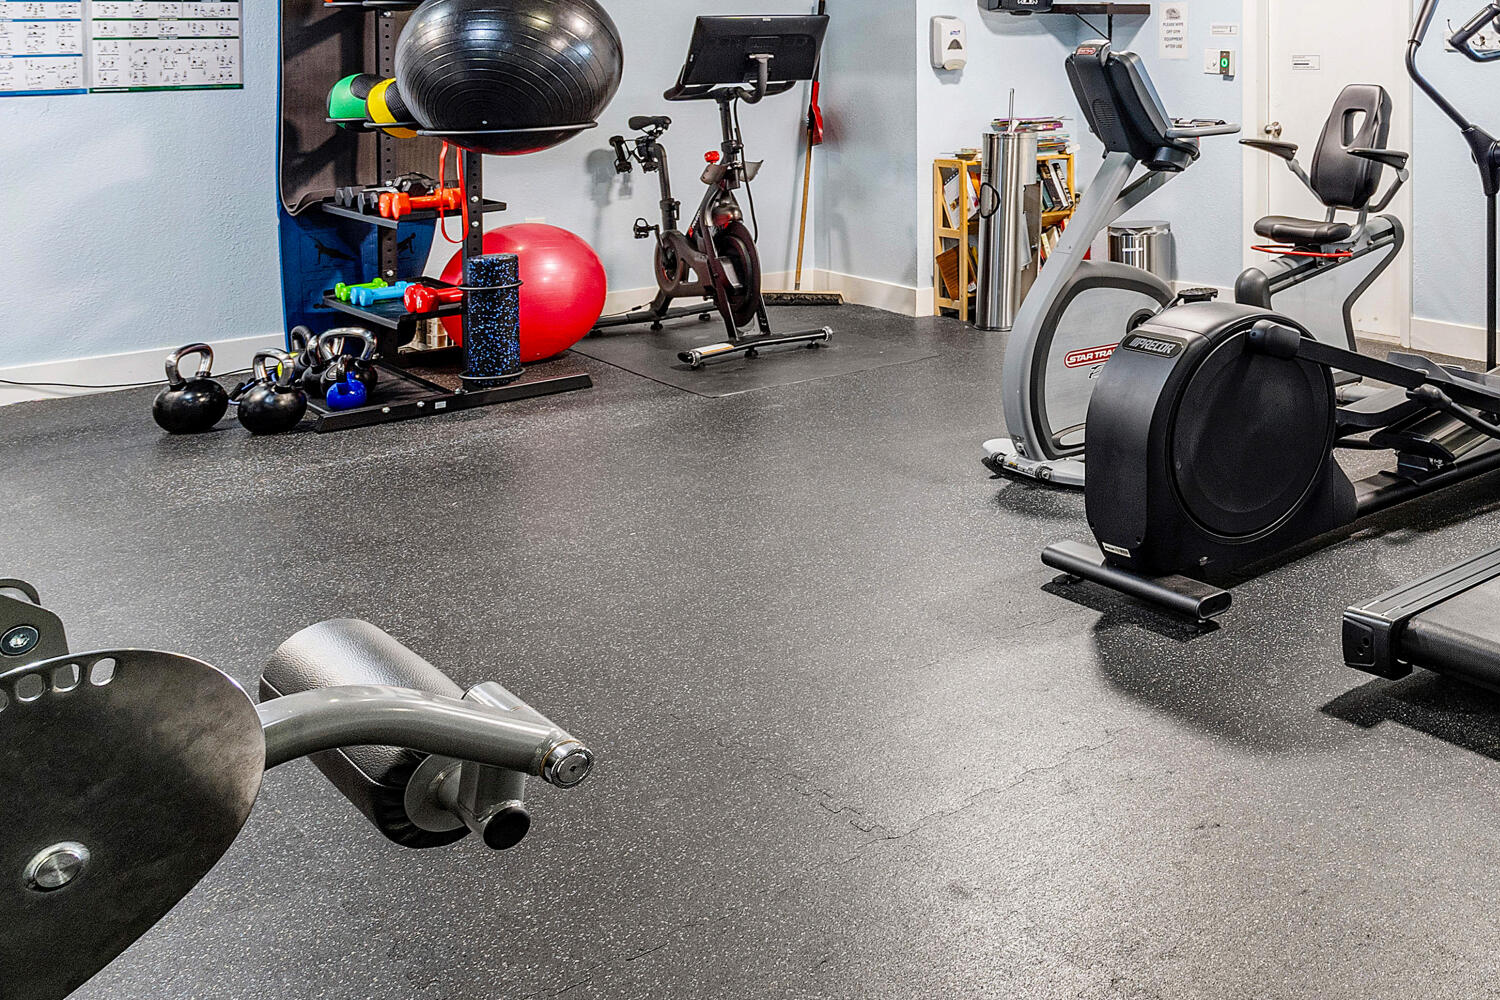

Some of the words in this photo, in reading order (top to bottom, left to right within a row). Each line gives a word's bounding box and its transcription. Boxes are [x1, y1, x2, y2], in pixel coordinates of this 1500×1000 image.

[1134, 337, 1176, 354] PRECOR
[1068, 351, 1093, 363] STAR
[1095, 348, 1116, 359] TRA
